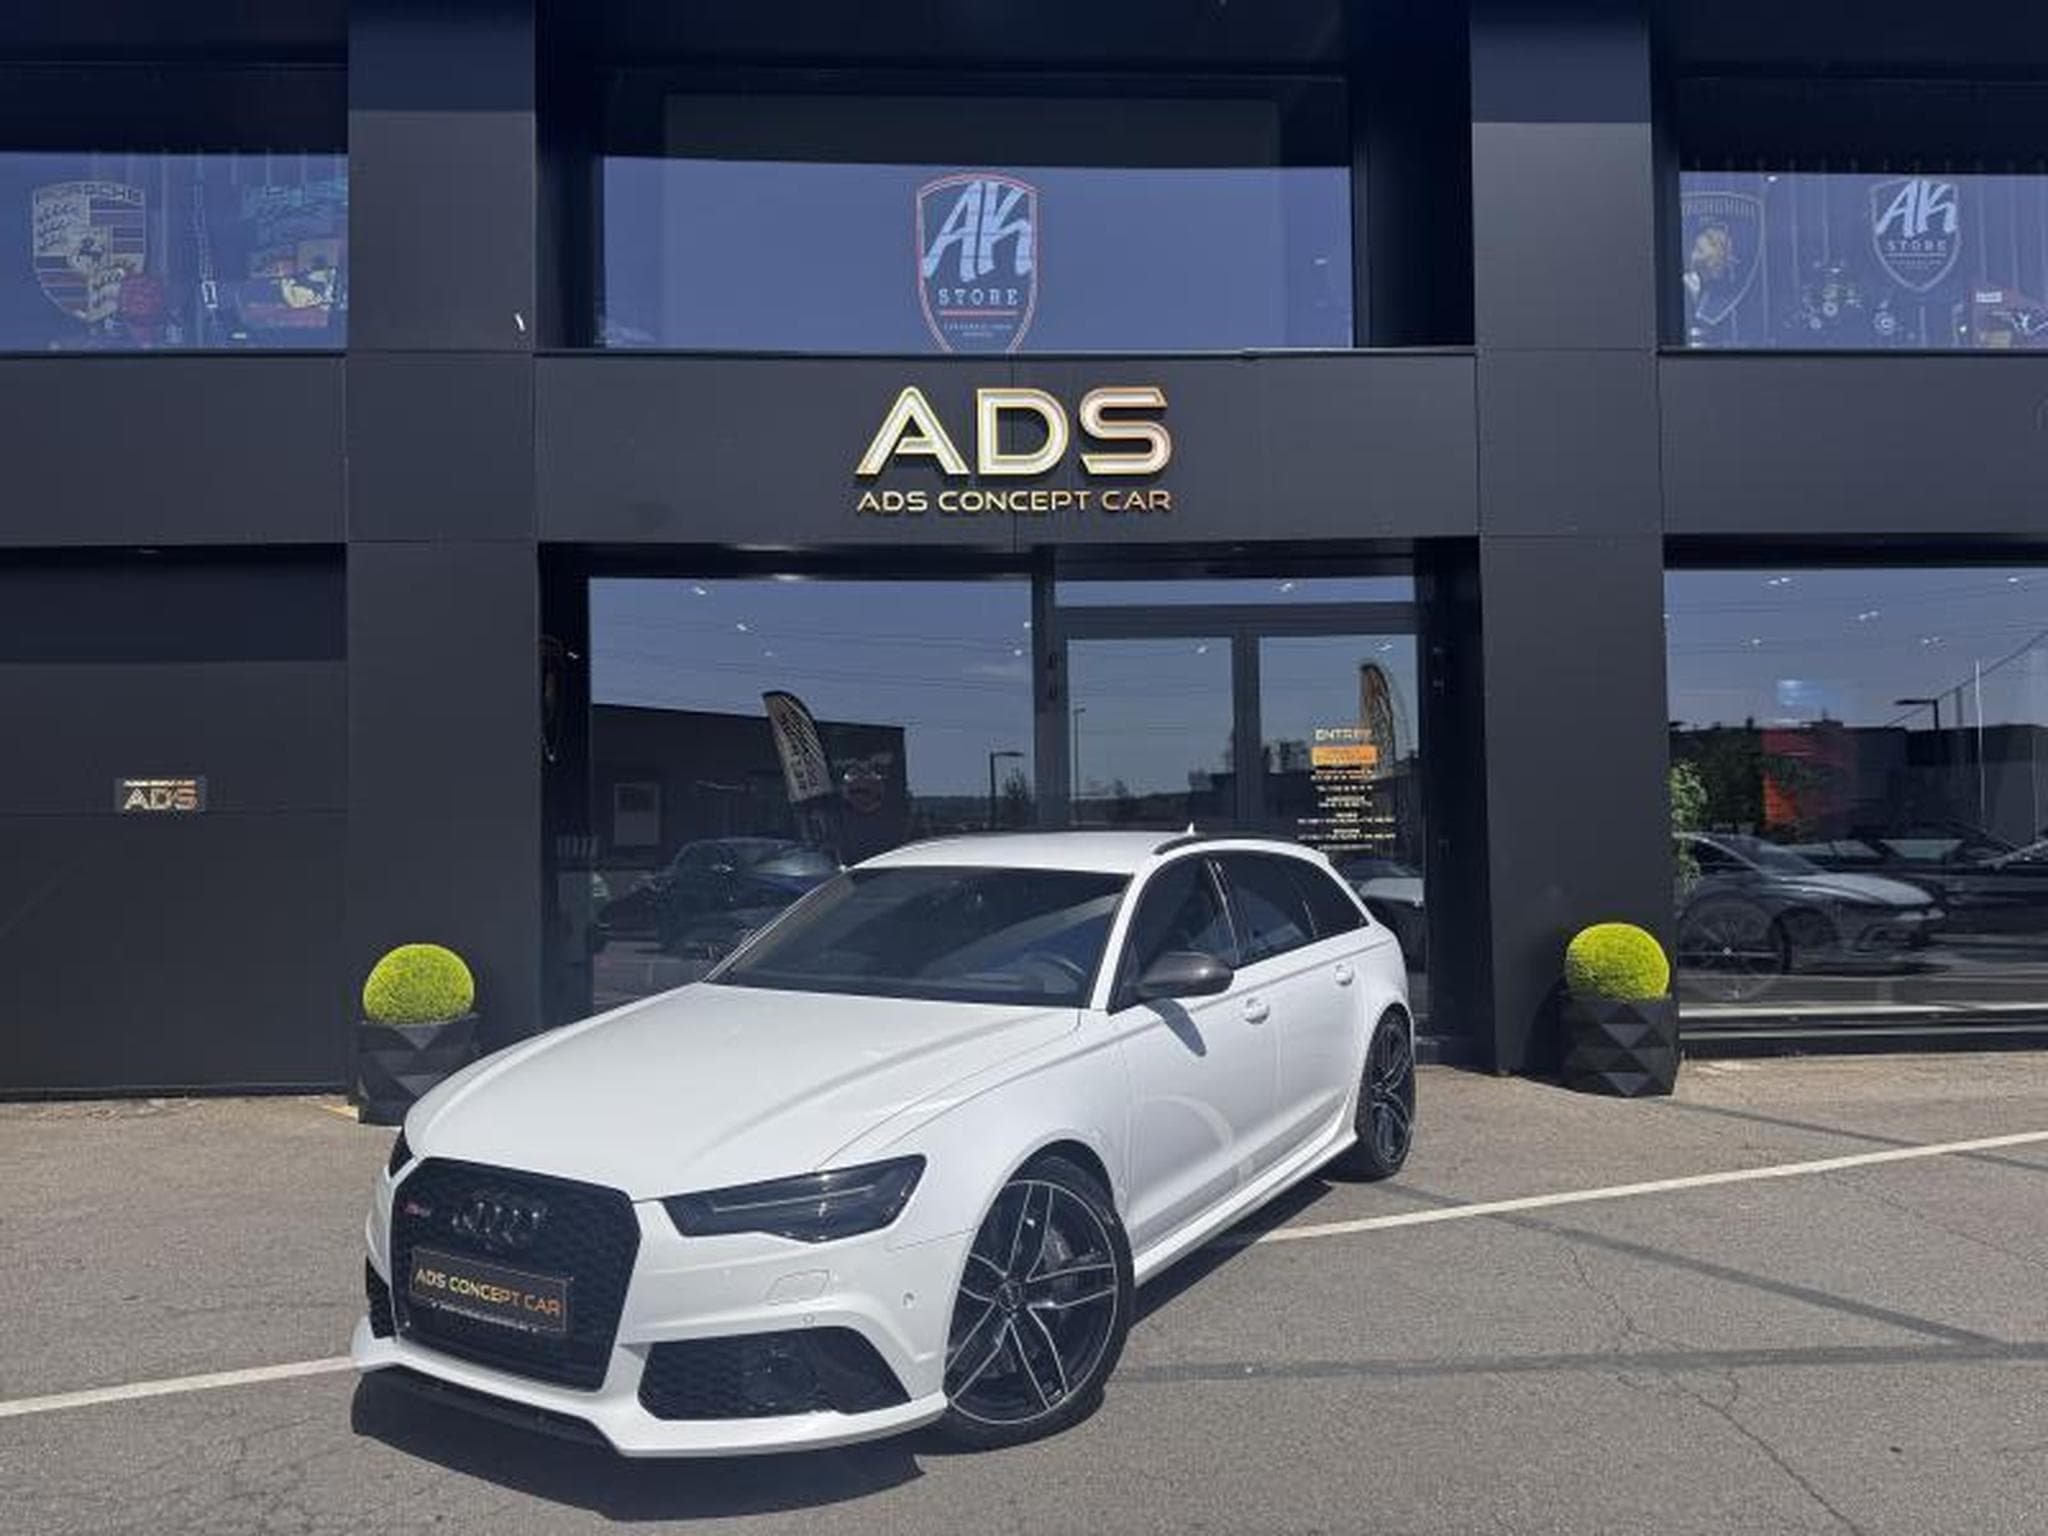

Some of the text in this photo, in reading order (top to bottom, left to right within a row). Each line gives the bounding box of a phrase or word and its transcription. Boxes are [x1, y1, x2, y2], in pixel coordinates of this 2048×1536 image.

[922, 180, 1032, 282] AK
[1875, 180, 1958, 238] AK
[938, 288, 1018, 306] STORE
[855, 385, 1172, 476] ADS
[857, 490, 1172, 513] ADS CONCEPT CAR
[122, 787, 199, 811] ADS
[414, 1268, 447, 1289] ADS
[447, 1276, 521, 1307] CONCEPT
[523, 1294, 562, 1317] CAR
